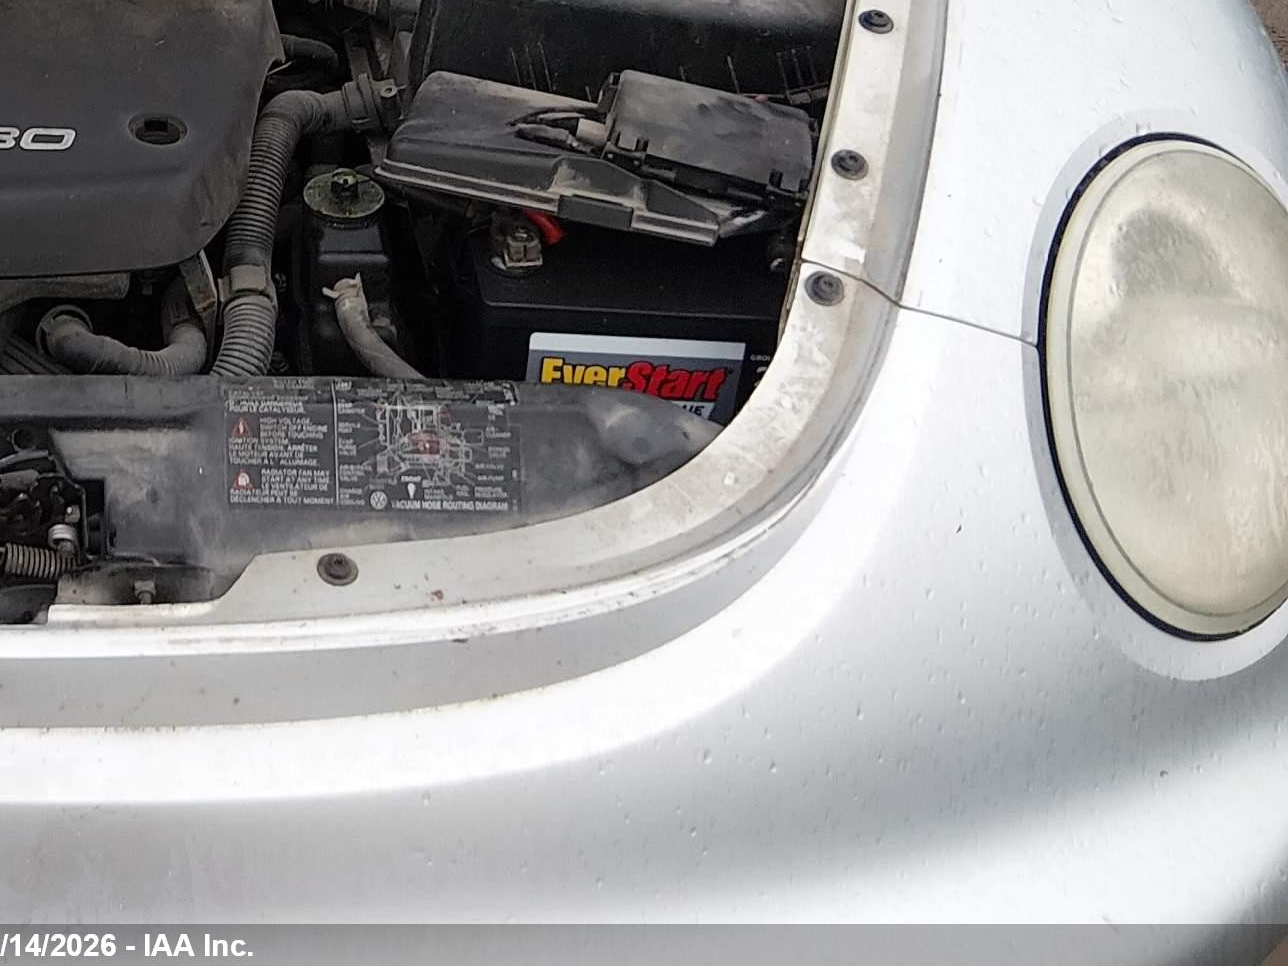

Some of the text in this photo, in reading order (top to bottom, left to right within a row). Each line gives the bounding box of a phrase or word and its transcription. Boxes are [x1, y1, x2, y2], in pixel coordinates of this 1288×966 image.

[539, 355, 729, 402] EverStart
[422, 501, 441, 510] HOSE
[442, 501, 474, 510] ROUTING
[475, 501, 508, 510] DIAGRAM
